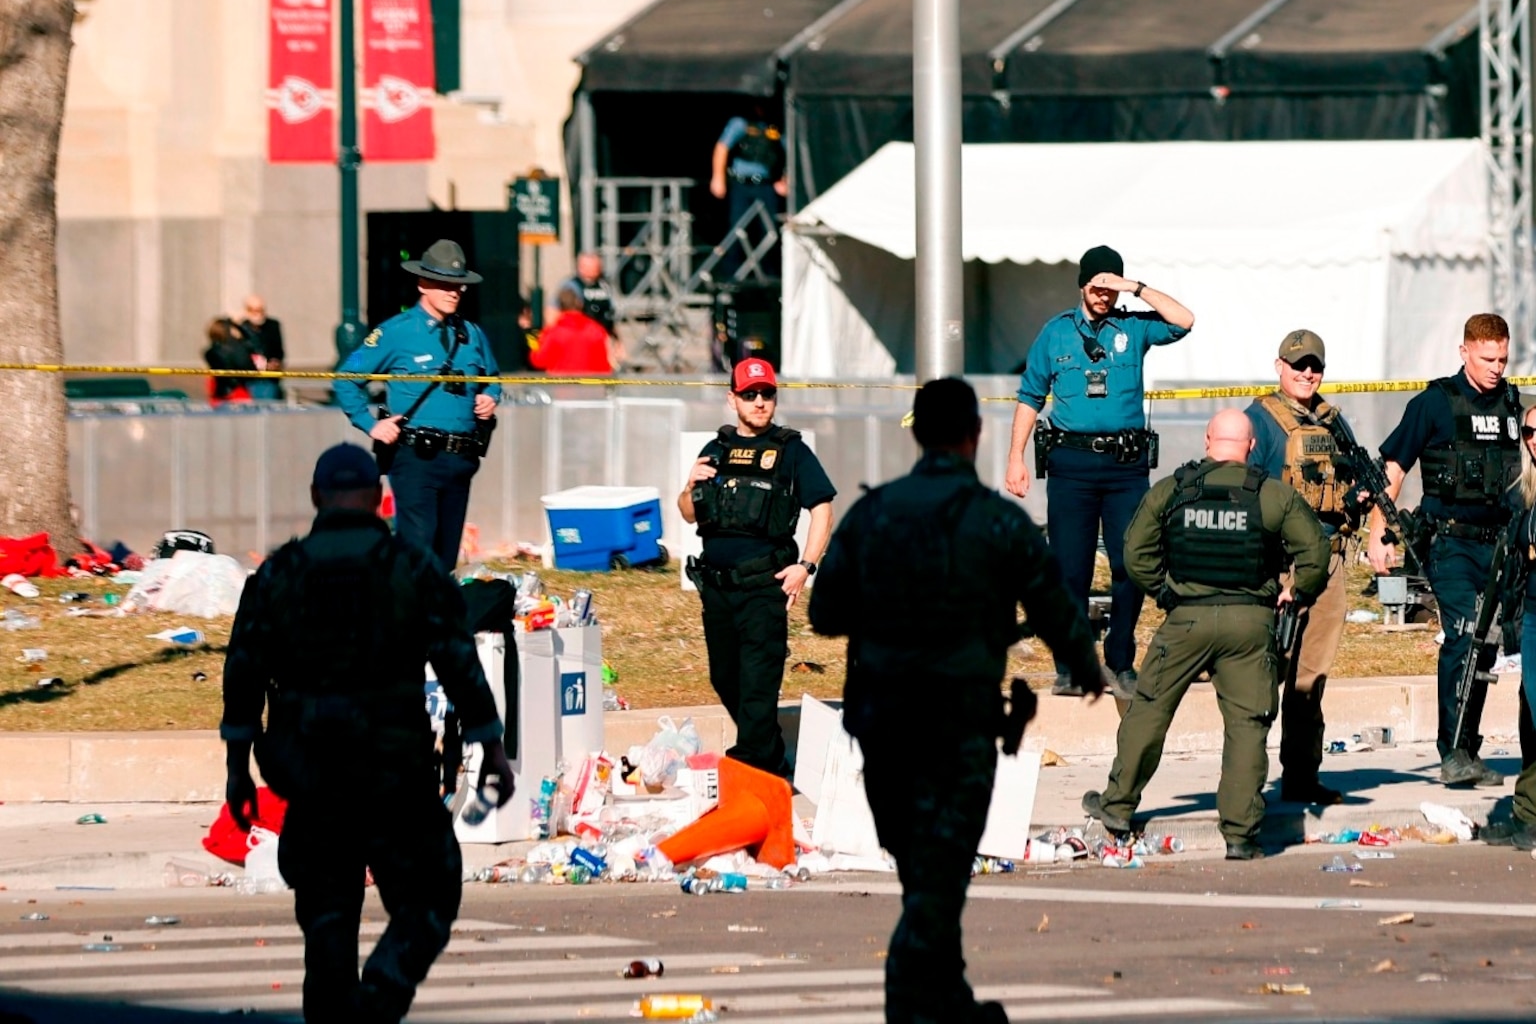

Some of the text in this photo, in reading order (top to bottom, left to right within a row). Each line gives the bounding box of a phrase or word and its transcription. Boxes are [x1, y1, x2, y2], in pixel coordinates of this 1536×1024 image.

[1471, 415, 1500, 433] POLICE
[729, 448, 757, 459] POLICE
[1183, 507, 1248, 531] POLICE
